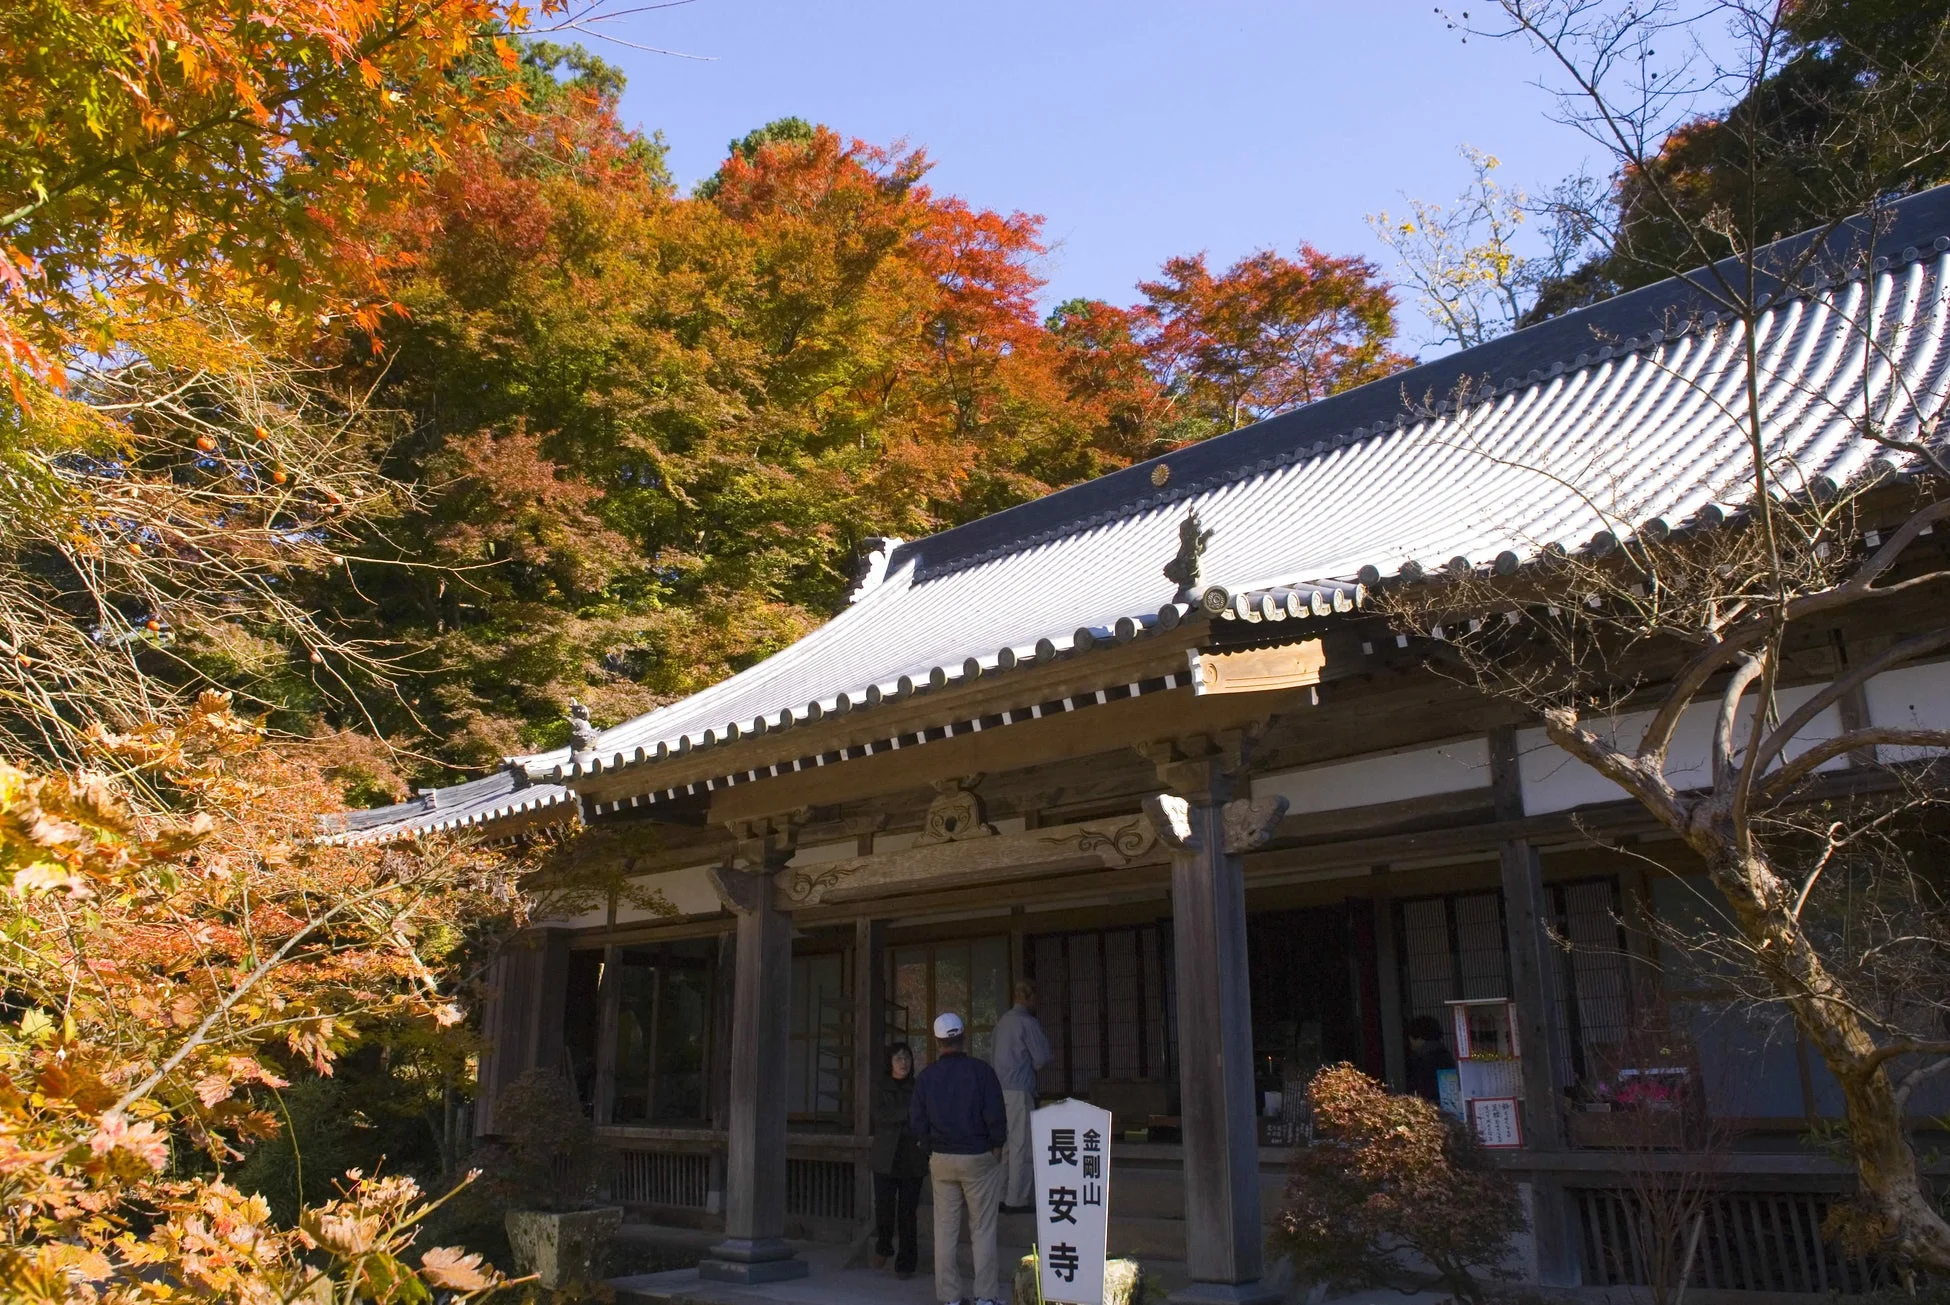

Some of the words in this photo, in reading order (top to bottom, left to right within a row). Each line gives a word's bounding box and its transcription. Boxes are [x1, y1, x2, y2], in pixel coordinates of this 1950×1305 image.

[1048, 1129, 1079, 1283] 長安寺
[1082, 1128, 1101, 1207] 金剛山
